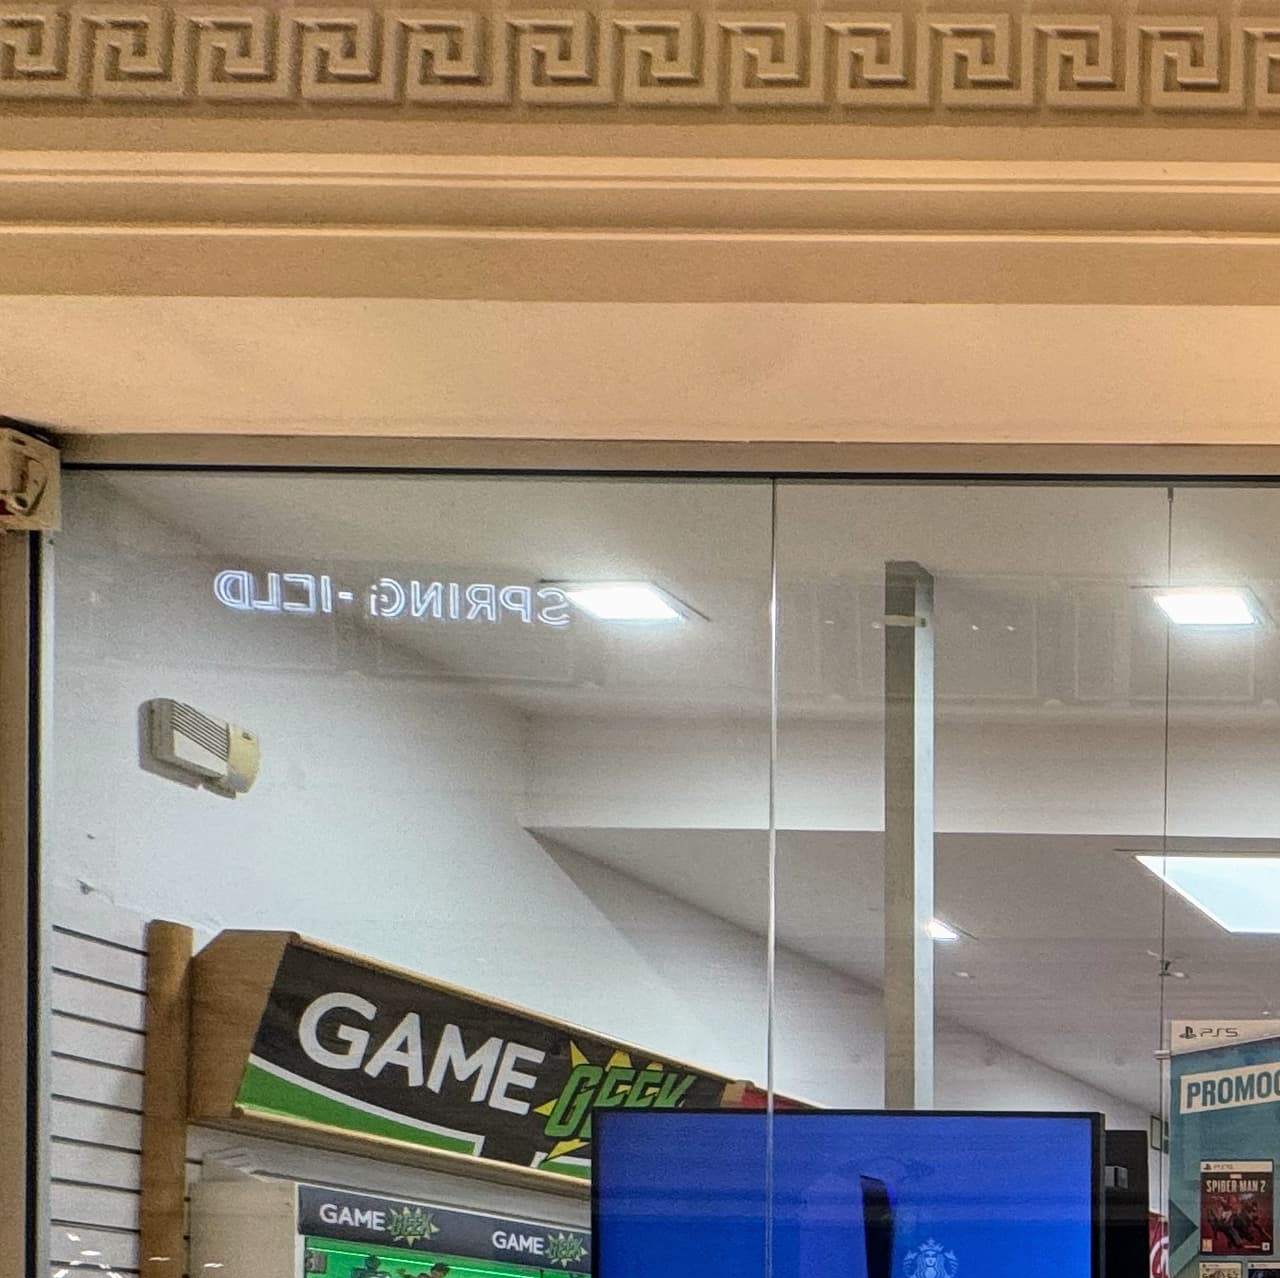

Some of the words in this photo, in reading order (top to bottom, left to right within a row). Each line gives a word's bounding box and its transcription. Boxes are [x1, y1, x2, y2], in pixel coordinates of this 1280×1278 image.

[1200, 1026, 1239, 1038] PS5
[298, 991, 547, 1117] GAME
[319, 1203, 386, 1231] GAME
[492, 1231, 544, 1255] GAME
